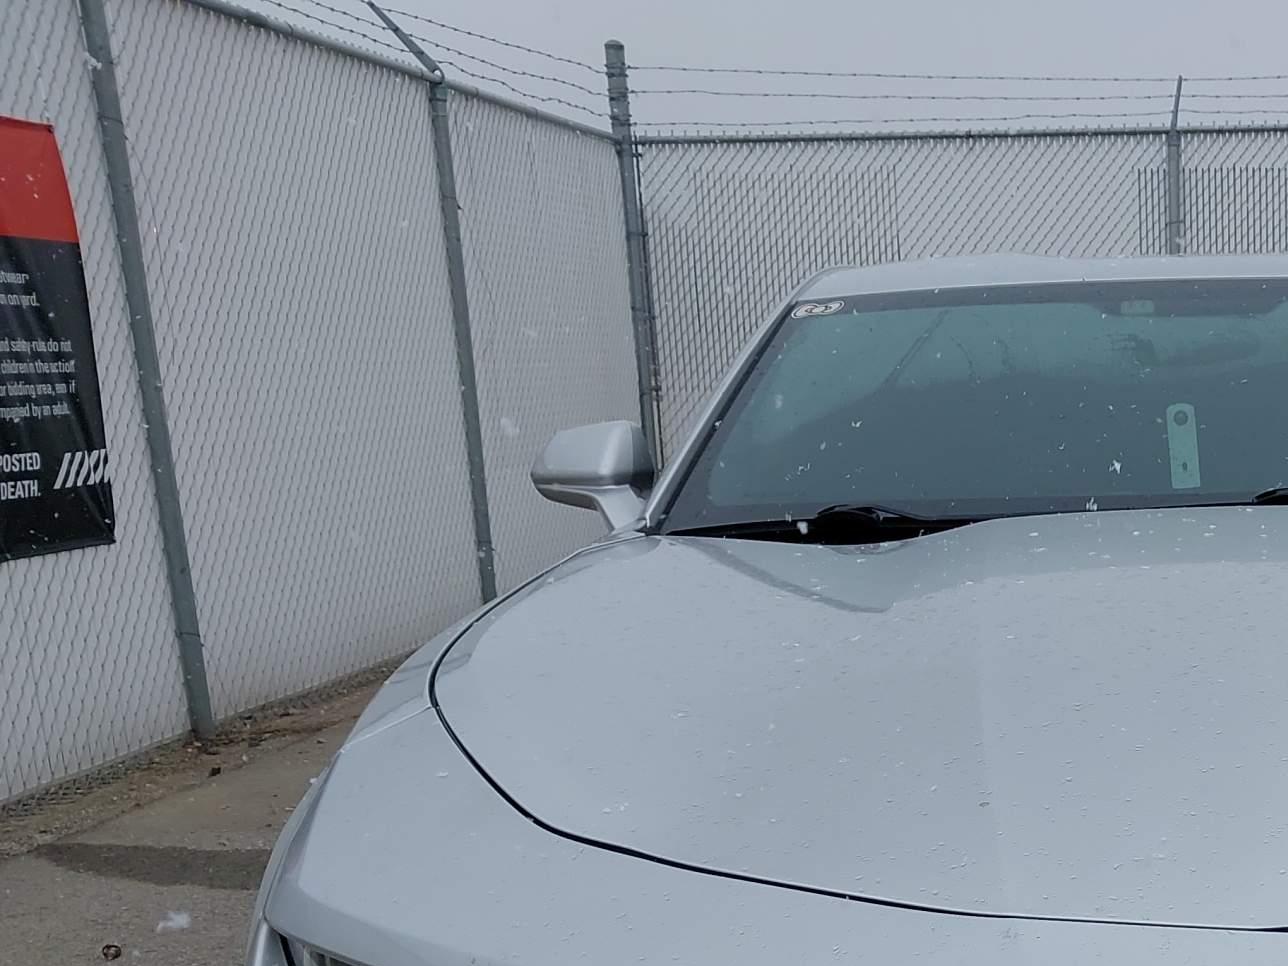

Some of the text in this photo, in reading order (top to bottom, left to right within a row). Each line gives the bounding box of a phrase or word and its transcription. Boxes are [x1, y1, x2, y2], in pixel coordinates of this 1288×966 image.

[47, 337, 59, 352] do
[35, 359, 50, 374] the
[69, 379, 76, 393] if
[31, 402, 42, 419] by
